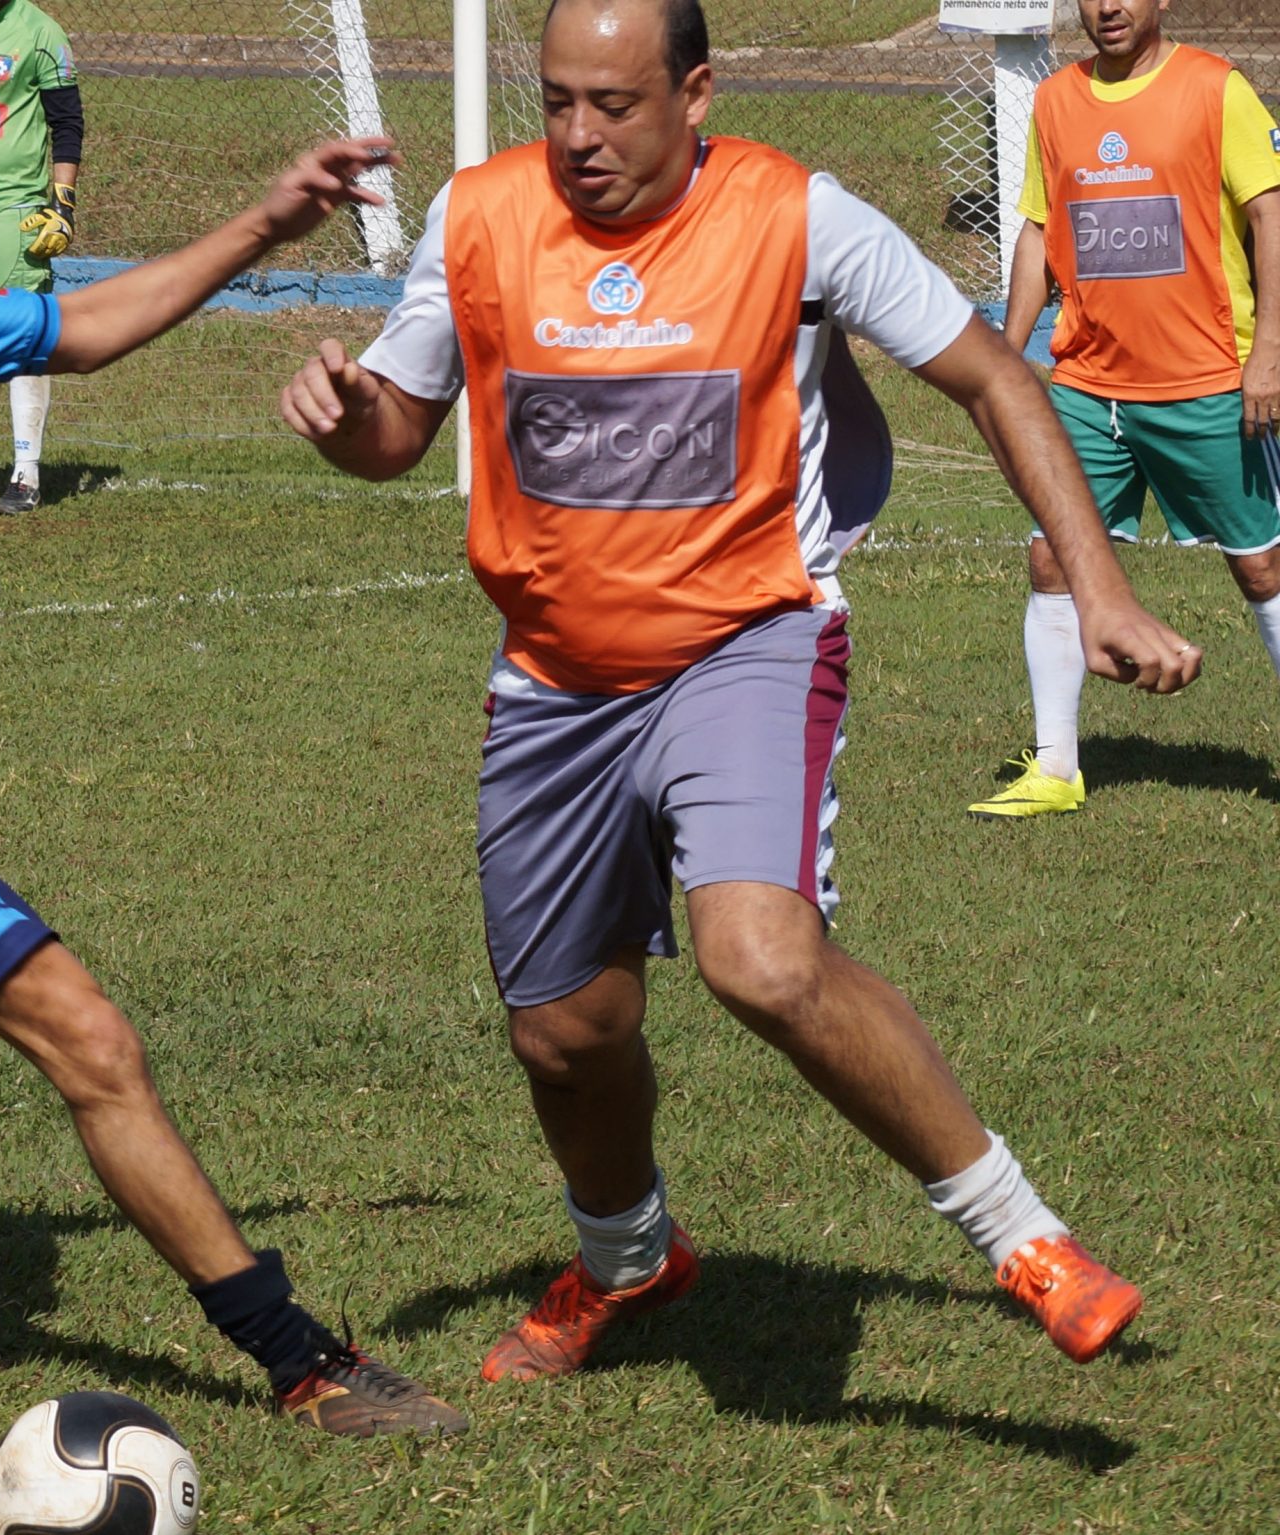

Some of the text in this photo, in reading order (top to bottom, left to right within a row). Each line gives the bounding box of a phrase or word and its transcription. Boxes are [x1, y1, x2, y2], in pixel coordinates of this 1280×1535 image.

[1003, 0, 1026, 9] nesta
[1075, 164, 1153, 185] Castelinho
[534, 318, 693, 349] Castelinho
[182, 1480, 195, 1508] 8
